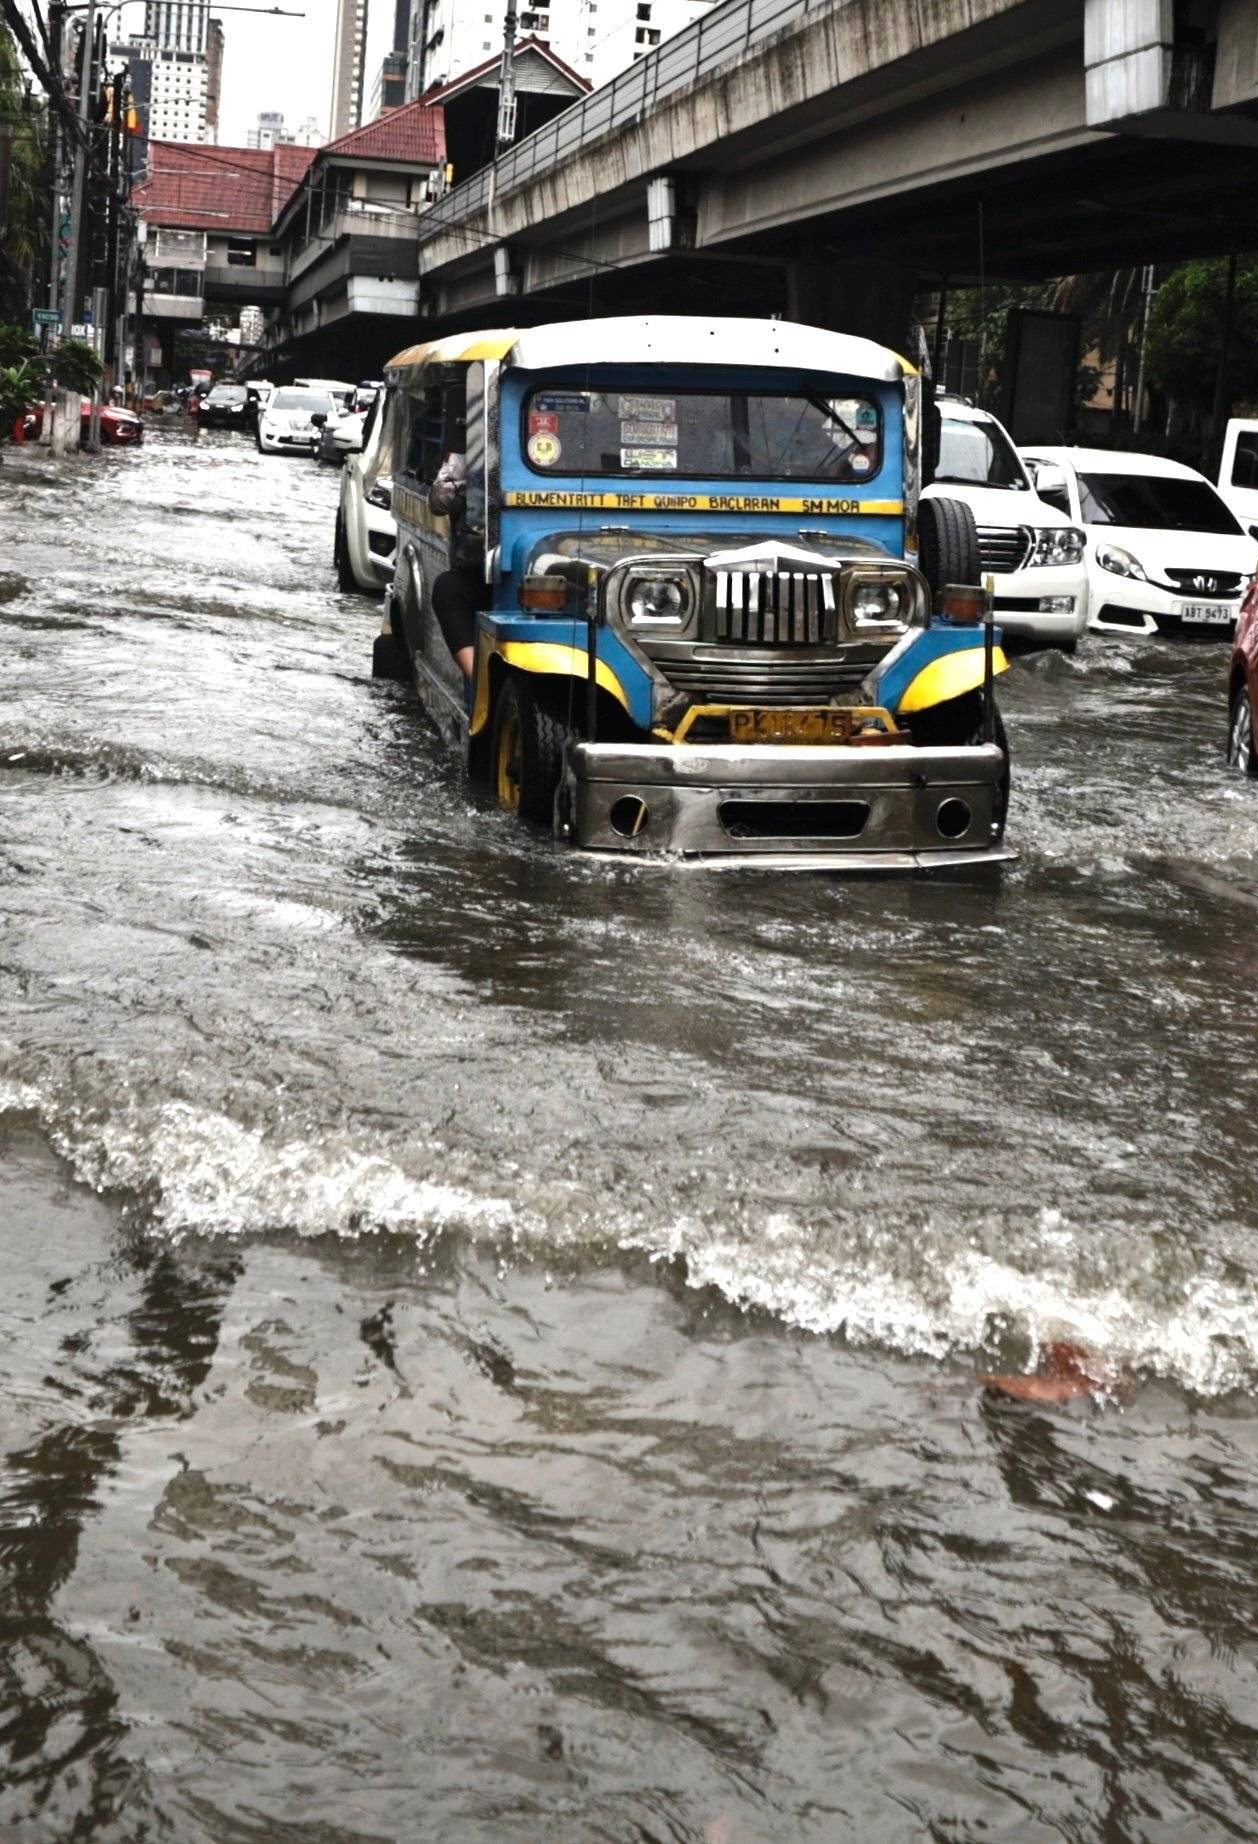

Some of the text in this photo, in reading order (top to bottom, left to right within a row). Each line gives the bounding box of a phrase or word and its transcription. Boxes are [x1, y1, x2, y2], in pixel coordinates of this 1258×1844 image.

[516, 492, 605, 507] BLUMENTRITT
[615, 494, 646, 507] TAFT
[709, 497, 780, 511] BACLARAN
[802, 500, 823, 513] SM
[827, 501, 860, 513] MOA
